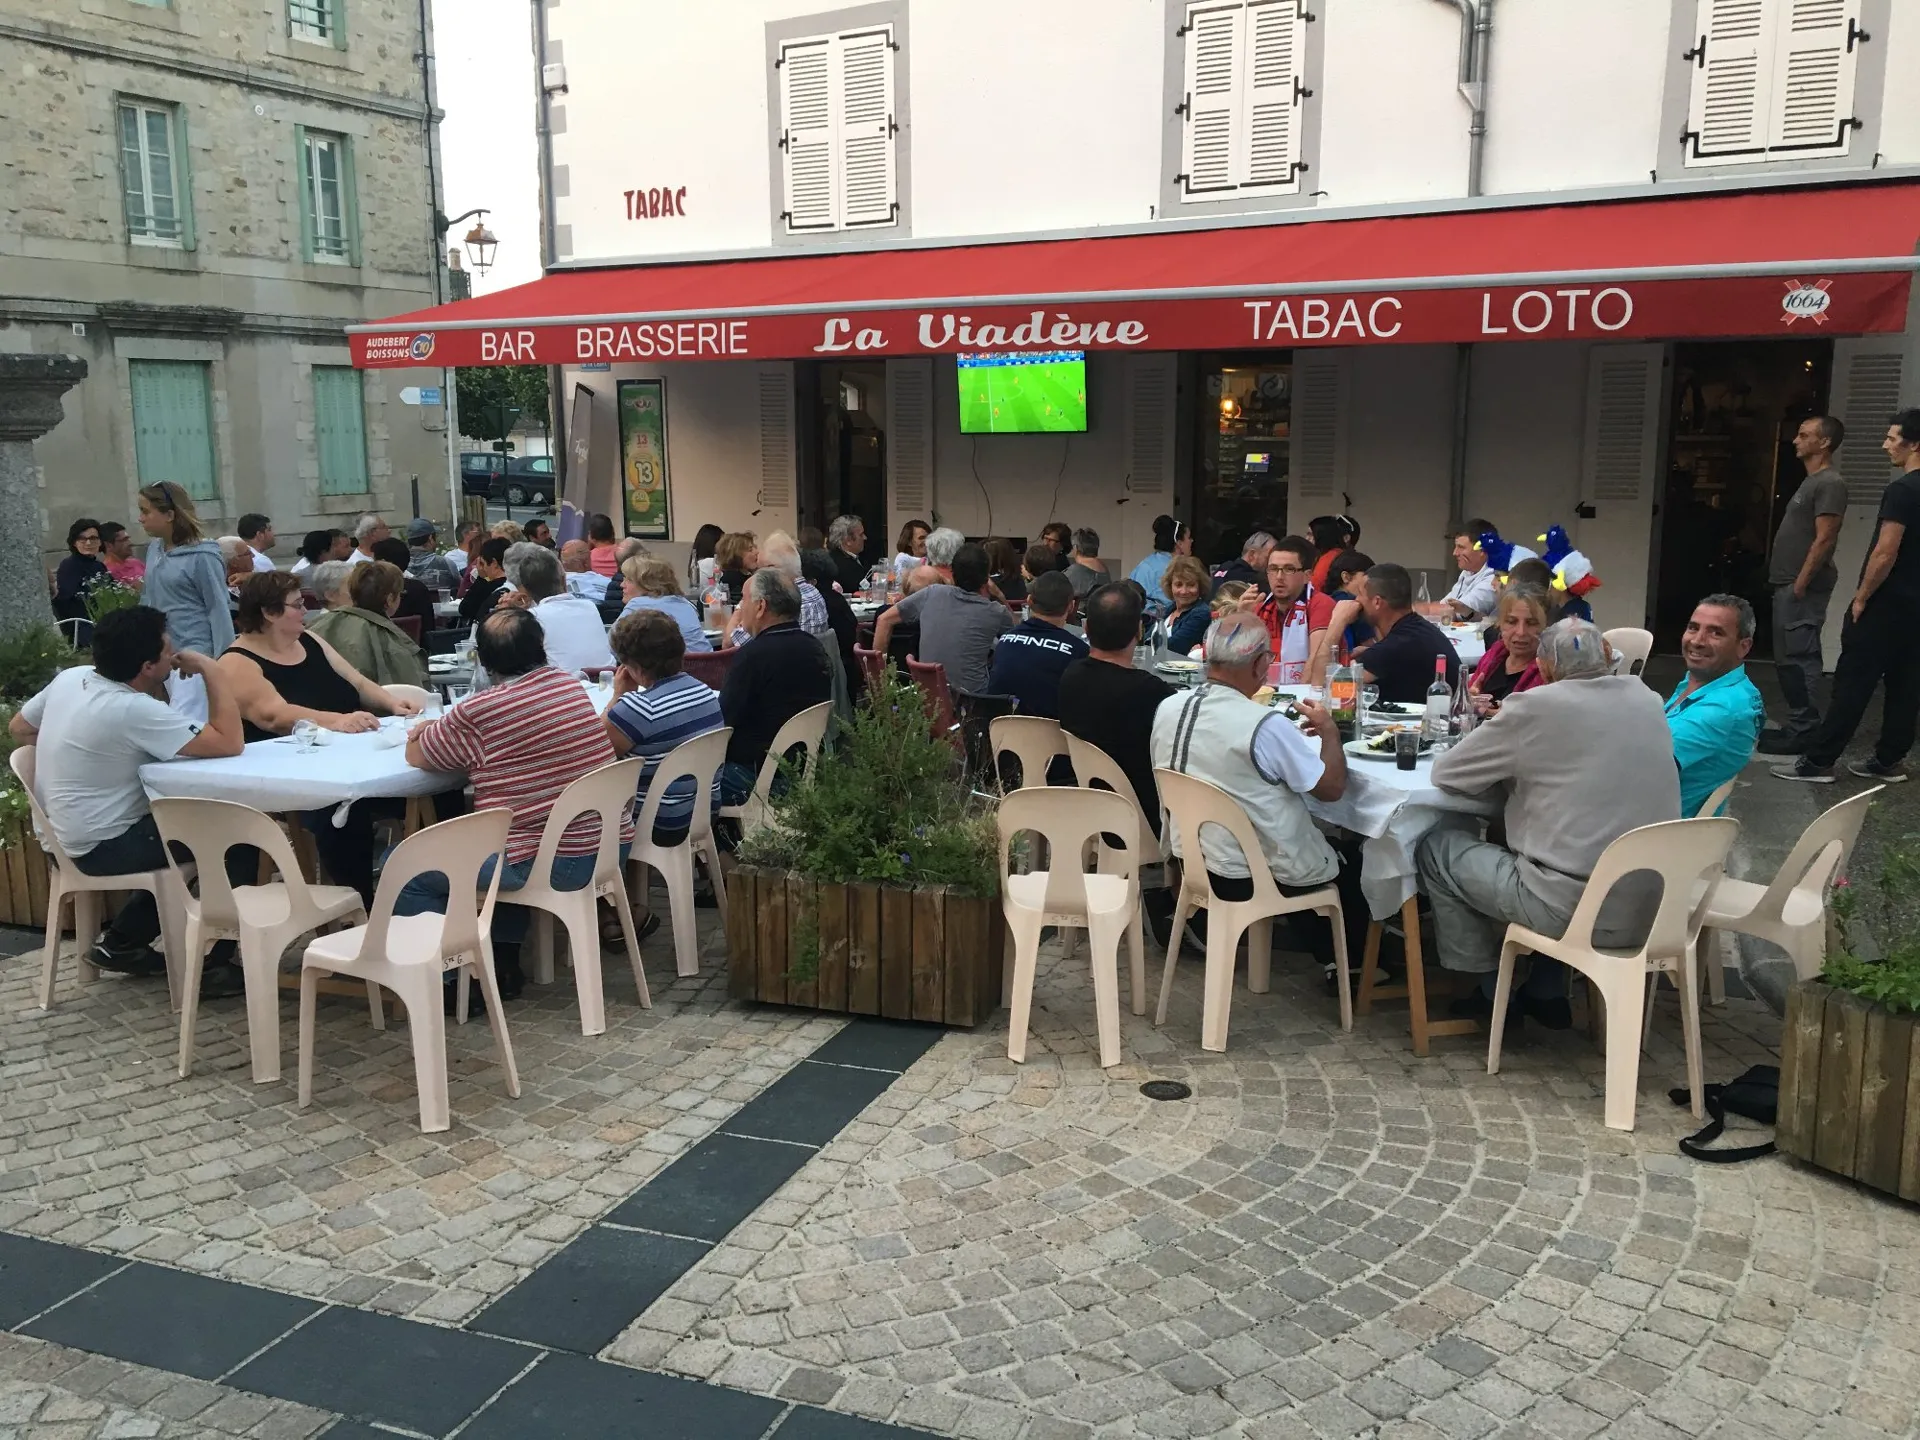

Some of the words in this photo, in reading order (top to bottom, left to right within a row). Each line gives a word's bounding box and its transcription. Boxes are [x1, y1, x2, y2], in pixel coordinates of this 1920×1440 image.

[624, 186, 686, 220] TABAC
[1481, 288, 1633, 334] LOTO
[1785, 292, 1826, 309] 1664
[813, 318, 889, 352] La
[918, 311, 1149, 348] Viadène
[1244, 297, 1402, 340] TABAC
[366, 336, 409, 348] AUDEBERT
[366, 348, 410, 359] BOISSONS
[413, 340, 430, 354] C10
[481, 331, 536, 361] BAR
[576, 321, 749, 358] BRASSERIE
[635, 461, 654, 486] 13
